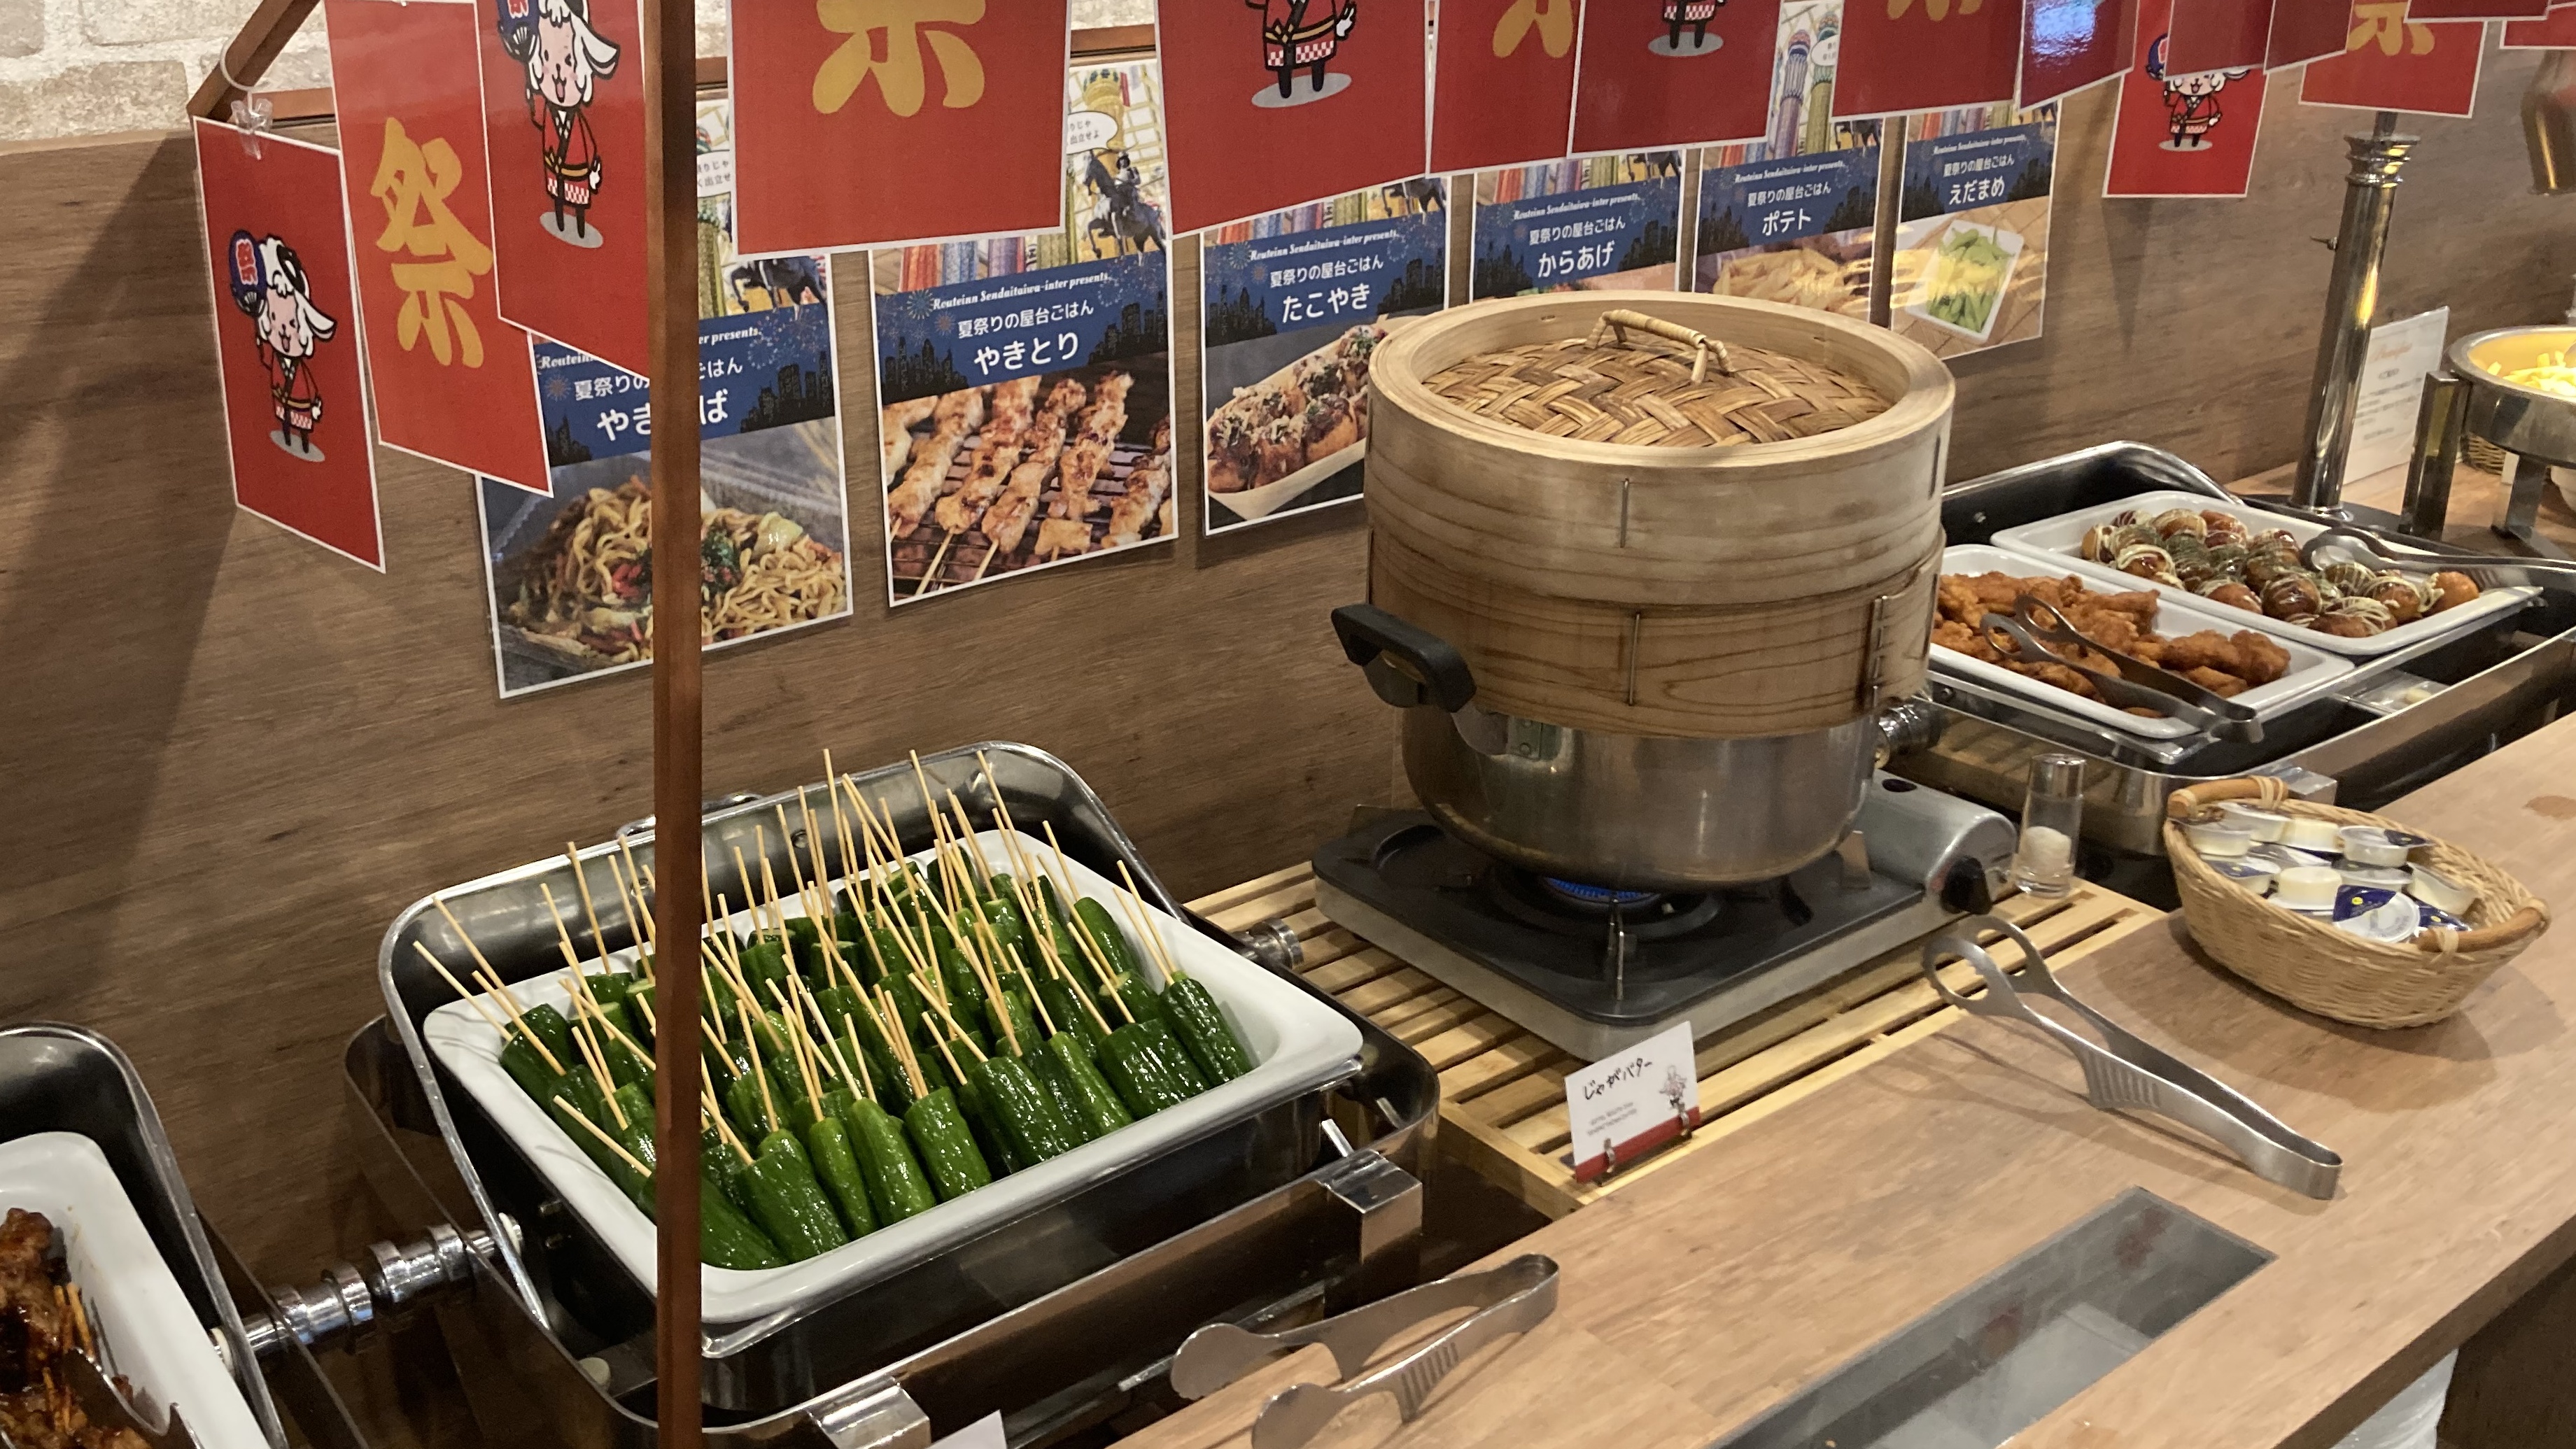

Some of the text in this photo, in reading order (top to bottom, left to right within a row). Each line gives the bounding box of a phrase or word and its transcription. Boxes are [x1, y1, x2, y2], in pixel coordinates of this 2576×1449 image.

[1747, 181, 1831, 207] 夏祭りの屋台ごはん
[1949, 176, 2005, 205] えだまめ
[1529, 215, 1626, 246] 夏祭りの屋台ごはん
[1762, 208, 1811, 236] ポテト
[370, 116, 493, 369] 祭
[1538, 240, 1615, 278] からあげ
[1270, 255, 1384, 288] 夏祭りの屋台ごはん
[957, 299, 1094, 339] 夏祭りの屋台ごはん
[1282, 283, 1370, 323] たこやき
[973, 332, 1078, 375] やきとり
[1582, 1058, 1652, 1101] じゃがバター
